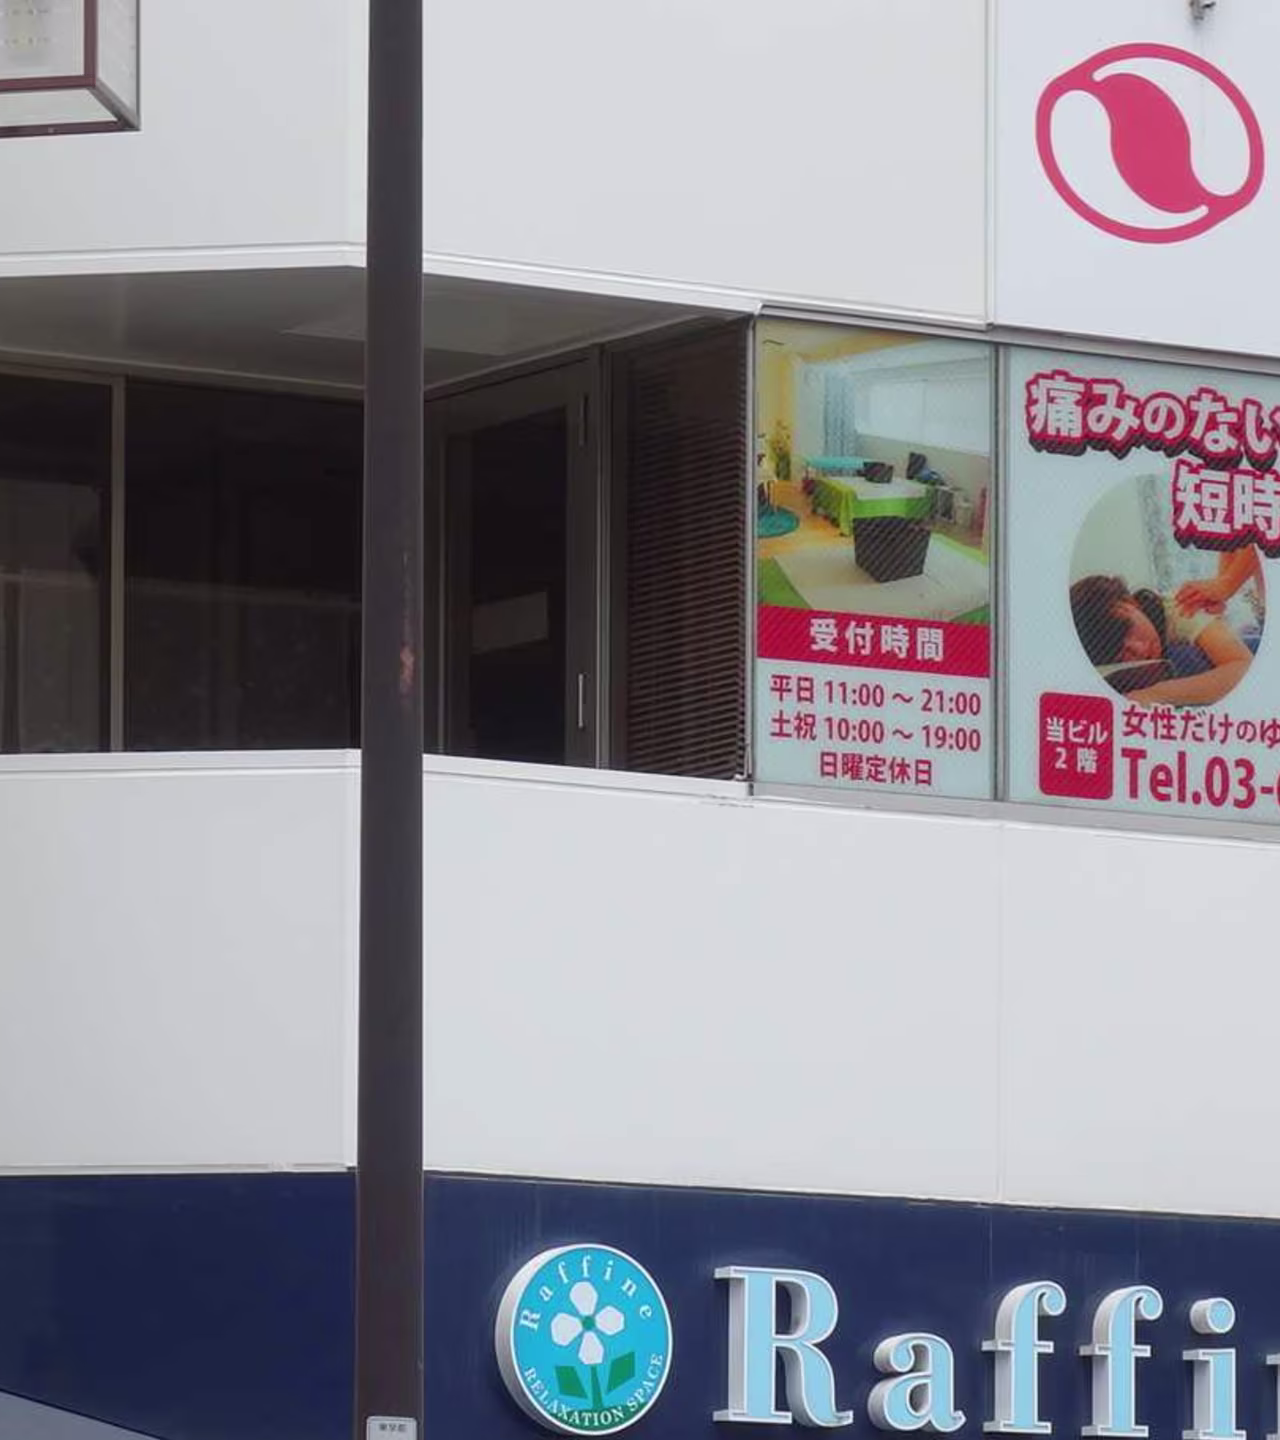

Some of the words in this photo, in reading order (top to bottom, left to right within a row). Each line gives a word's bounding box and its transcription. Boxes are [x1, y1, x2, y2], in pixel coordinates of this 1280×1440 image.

[809, 616, 946, 664] 受付時間
[770, 673, 815, 705] 平日
[824, 679, 885, 710] 11:00
[921, 686, 982, 718] 21:00
[770, 711, 818, 743] 土祝
[825, 716, 886, 747] 10:00
[921, 722, 982, 755] 19:00
[1044, 719, 1107, 748] 当ビル
[818, 751, 934, 787] 日曜定休日
[519, 1255, 654, 1332] Raffine
[524, 1366, 625, 1427] RELAXATION
[626, 1352, 664, 1412] SPACE
